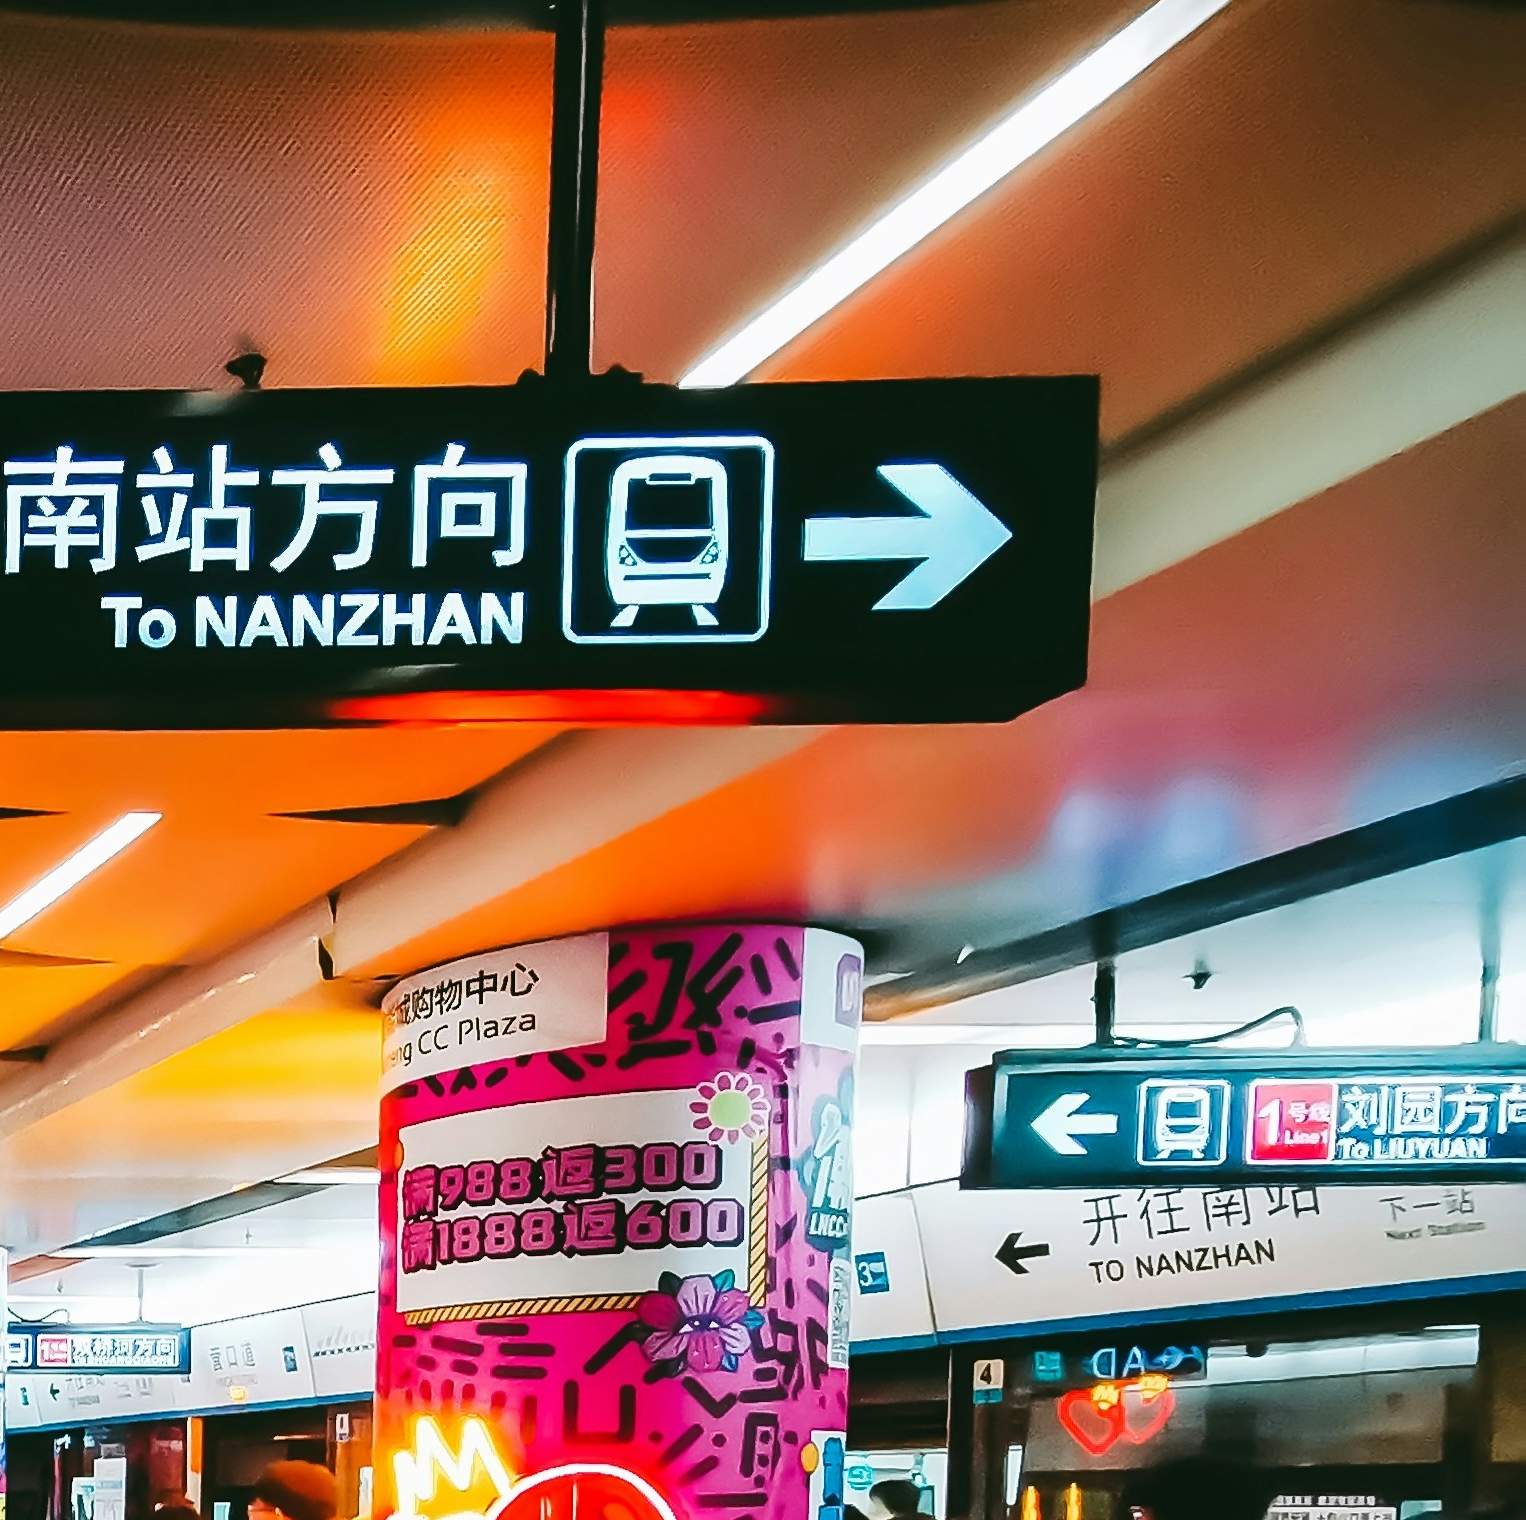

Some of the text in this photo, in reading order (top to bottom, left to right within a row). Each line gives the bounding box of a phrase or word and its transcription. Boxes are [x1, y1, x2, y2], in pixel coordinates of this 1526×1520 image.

[3, 444, 529, 575] 南站方向
[100, 593, 526, 648] To NANZHAN
[418, 1025, 449, 1055] CC
[458, 1013, 537, 1046] Plaza
[1336, 1135, 1489, 1159] To LIUYUAN
[1378, 1188, 1477, 1222] 下一站
[1089, 1238, 1276, 1284] TO NANZHAN
